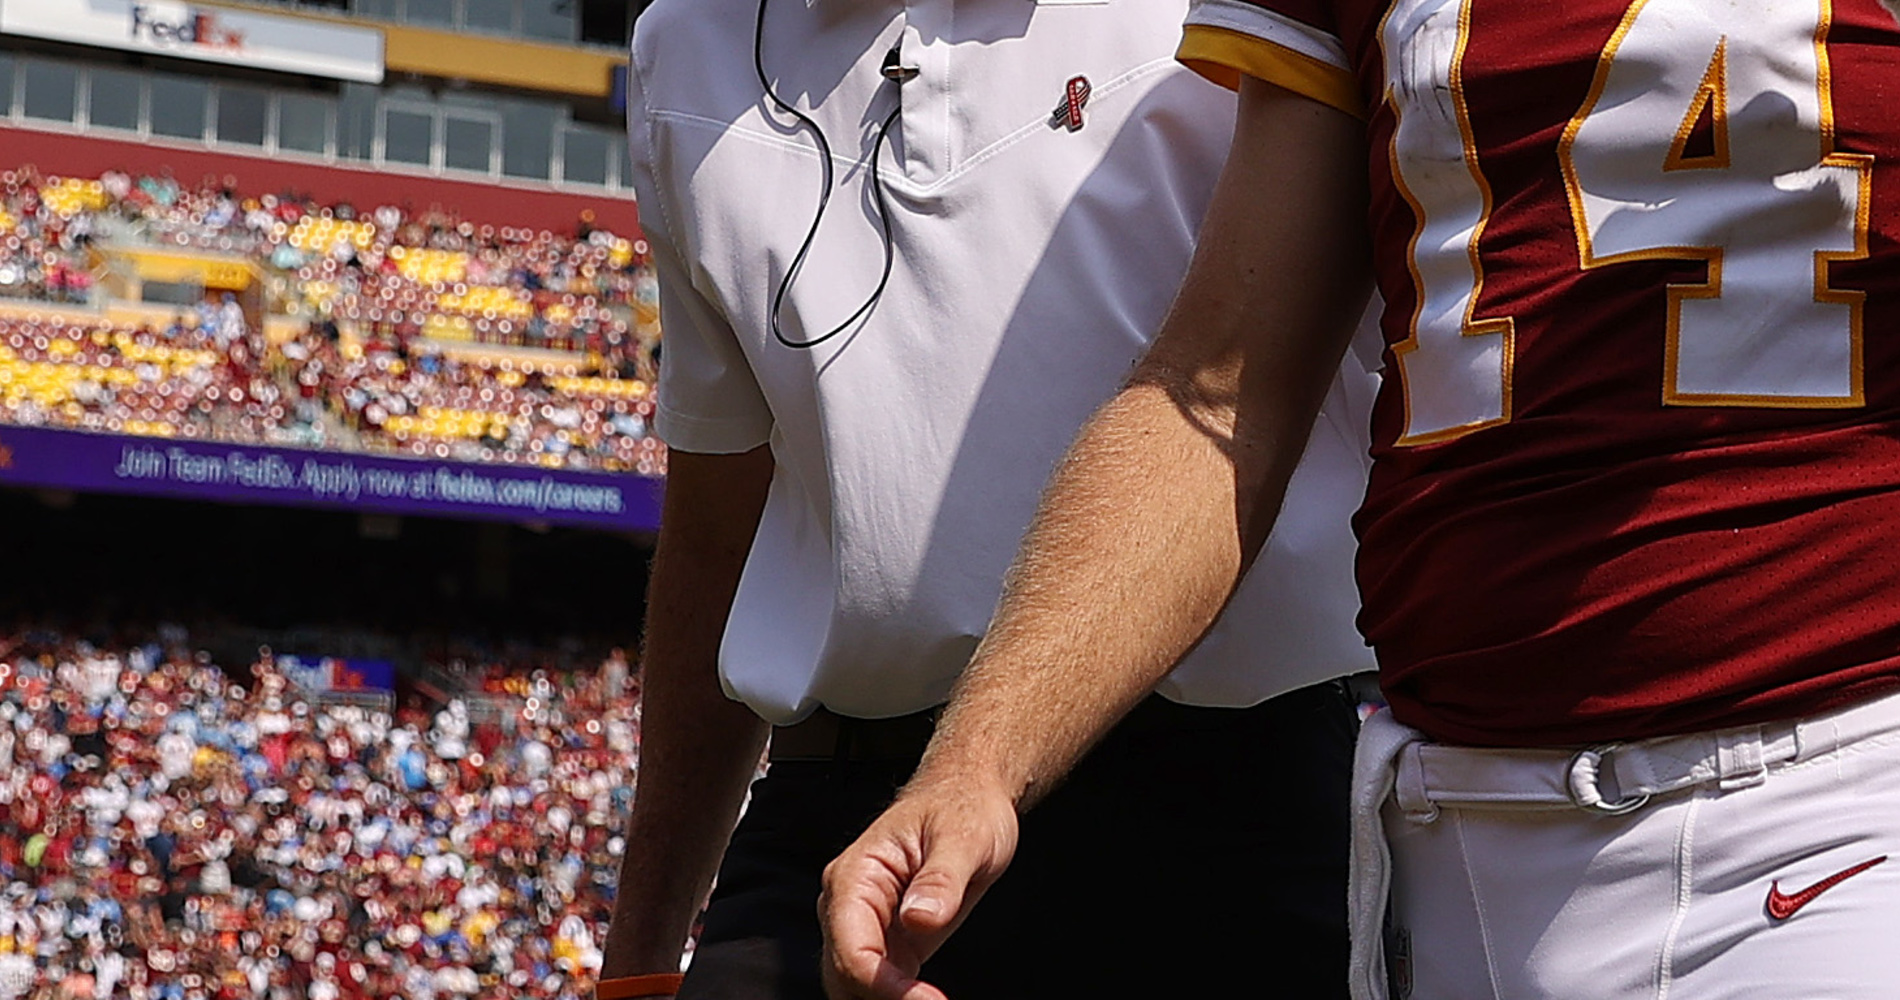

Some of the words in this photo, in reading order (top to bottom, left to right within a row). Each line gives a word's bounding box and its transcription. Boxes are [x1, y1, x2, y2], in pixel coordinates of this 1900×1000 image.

[130, 3, 244, 53] FedEx
[115, 444, 166, 478] Join
[167, 447, 227, 484] Team
[301, 458, 362, 500] Apply
